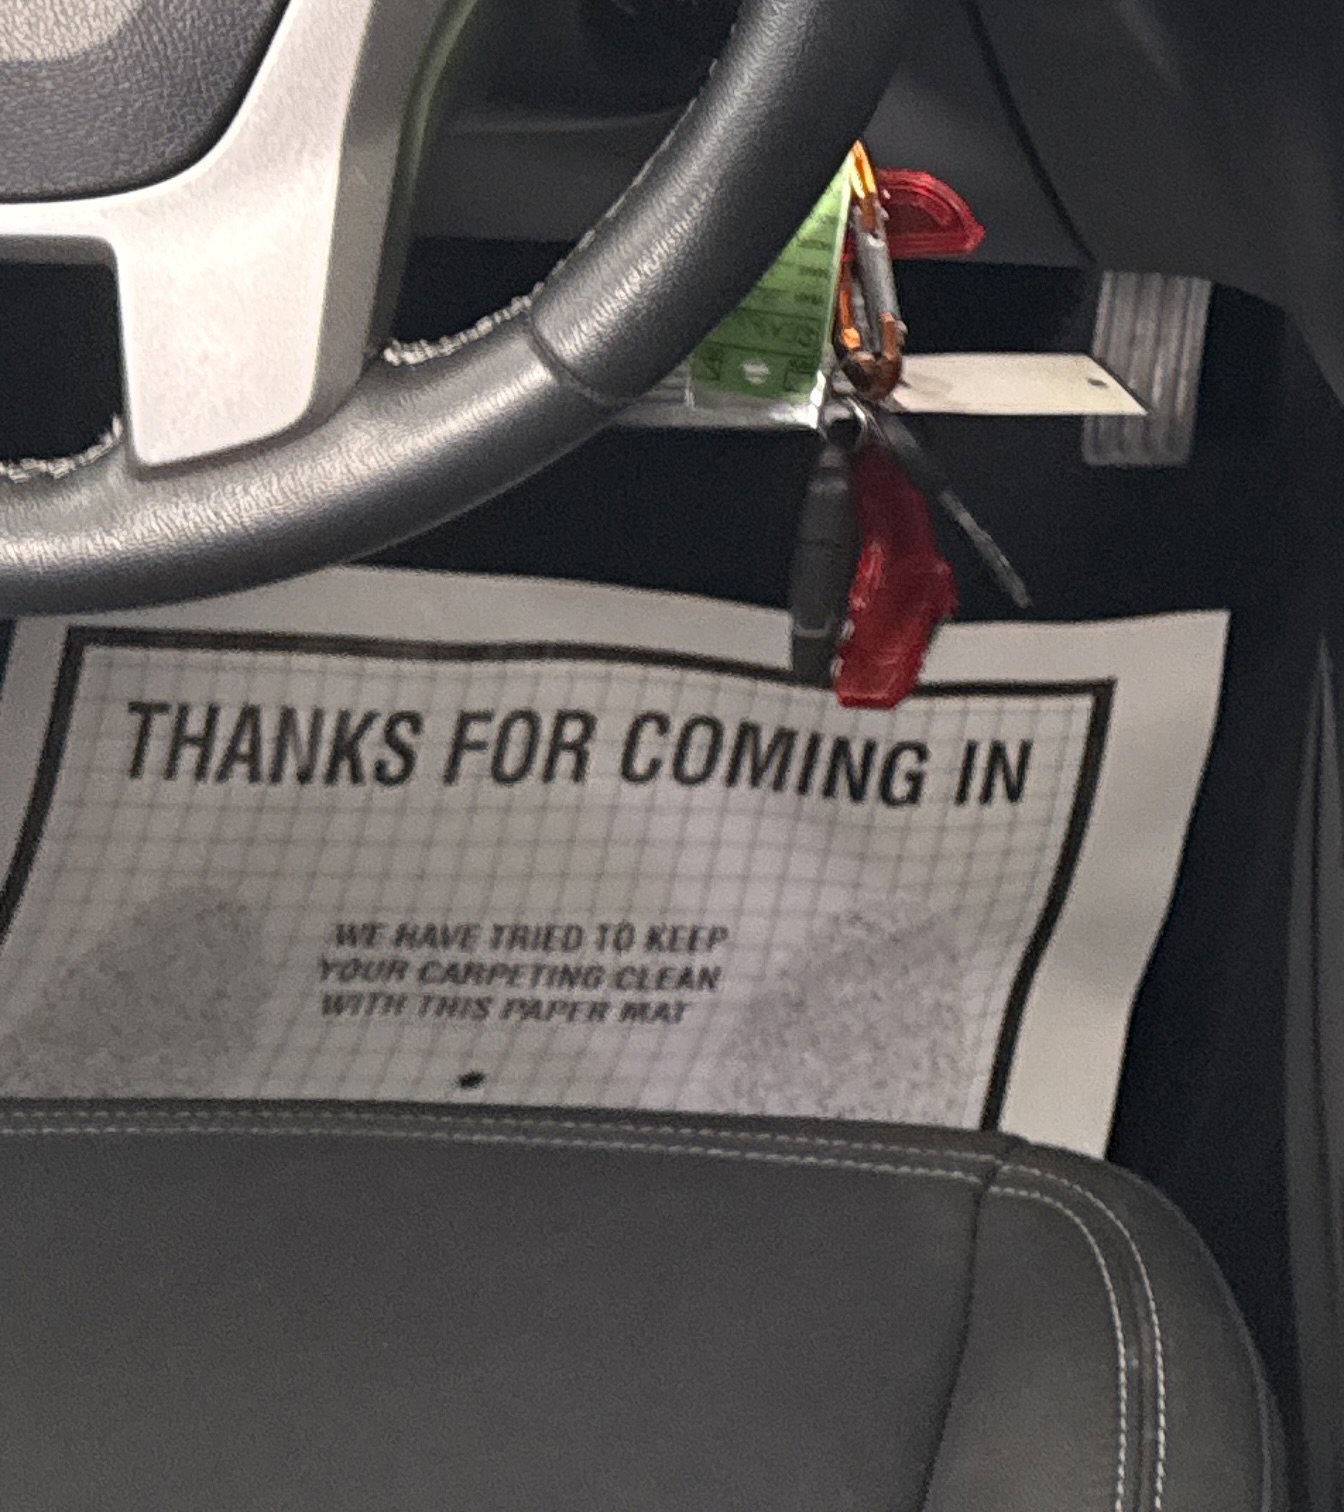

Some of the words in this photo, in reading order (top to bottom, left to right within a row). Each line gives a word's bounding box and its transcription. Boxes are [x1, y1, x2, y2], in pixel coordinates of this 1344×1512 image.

[126, 698, 426, 788] THANKS
[441, 708, 598, 788] FOR
[620, 710, 932, 807] COMING
[952, 737, 1034, 805] IN
[335, 921, 387, 948] WE
[394, 921, 481, 951] HAVE
[488, 922, 586, 952] TRIED
[594, 921, 637, 953] TO
[643, 923, 730, 953] KEEP
[318, 954, 409, 985] YOUR
[417, 958, 607, 989] CARPETING
[614, 963, 723, 993] CLEAN
[321, 992, 408, 1018] WITH
[418, 994, 494, 1023] THIS
[500, 997, 611, 1024] PAPER
[618, 999, 690, 1026] MAT
